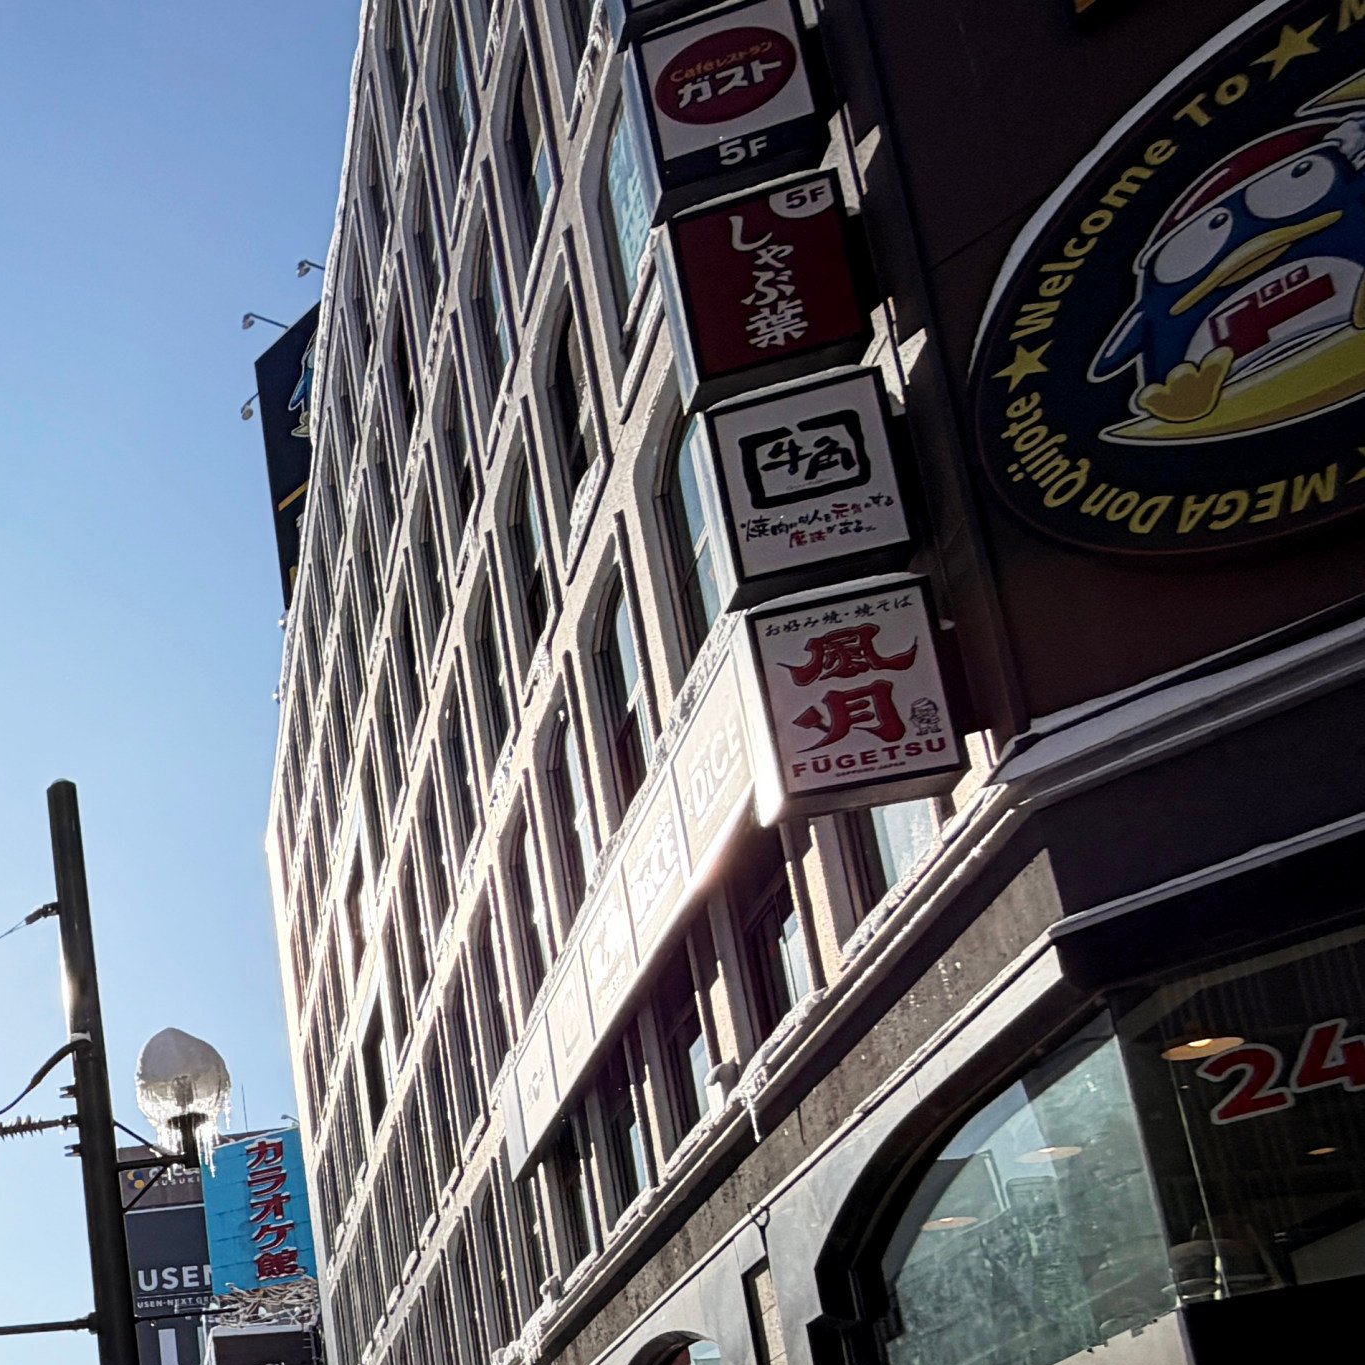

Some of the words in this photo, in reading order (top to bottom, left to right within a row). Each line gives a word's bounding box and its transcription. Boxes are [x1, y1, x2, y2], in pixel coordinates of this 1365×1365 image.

[677, 59, 782, 110] ガスト
[718, 136, 768, 166] 5F
[785, 185, 826, 209] 5F
[1009, 137, 1179, 343] Welcome
[1173, 73, 1251, 129] To
[728, 215, 809, 348] しゃぶ葉
[761, 436, 856, 480] 牛角
[1000, 391, 1094, 509] Quijote
[1079, 493, 1168, 536] Don
[1177, 462, 1340, 537] MEGA
[777, 623, 918, 754] 風月
